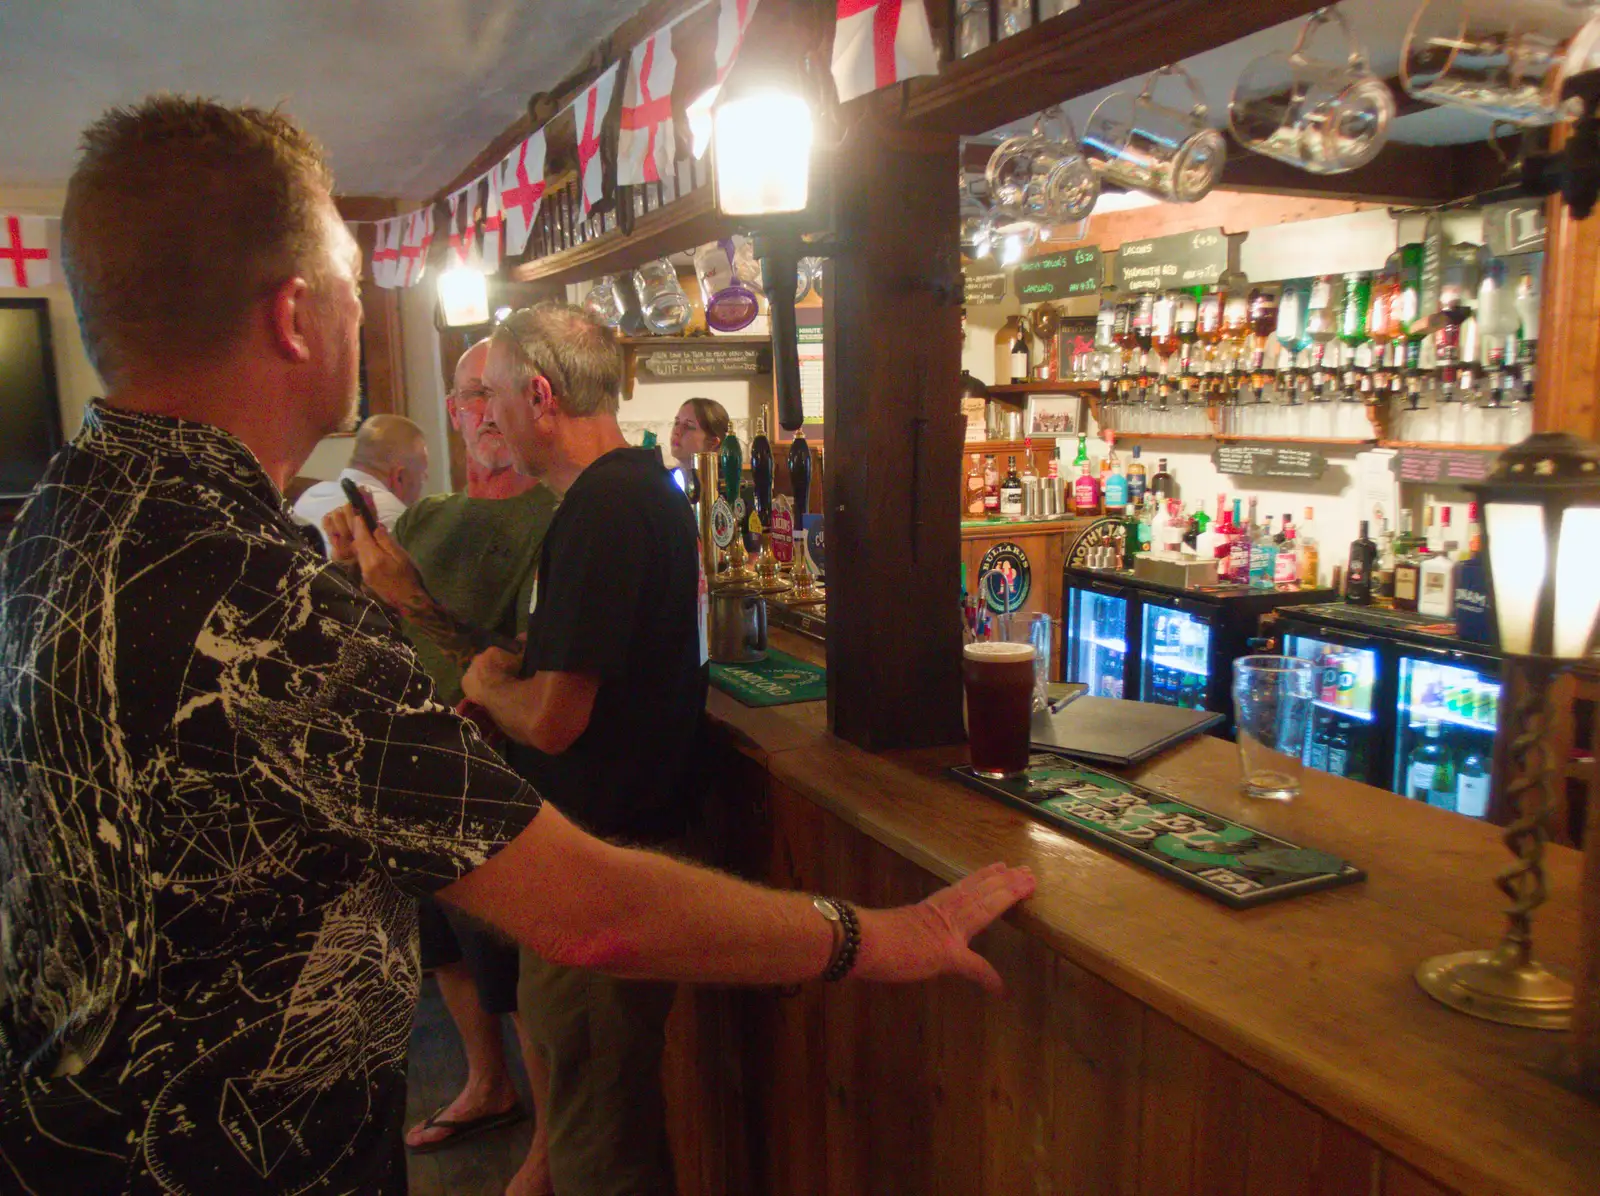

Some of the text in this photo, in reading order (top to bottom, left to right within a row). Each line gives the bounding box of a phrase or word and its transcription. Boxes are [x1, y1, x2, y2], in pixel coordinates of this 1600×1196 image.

[983, 543, 1029, 571] BULLARDS
[1071, 526, 1103, 568] MOTHY
[1197, 868, 1264, 894] IPA
